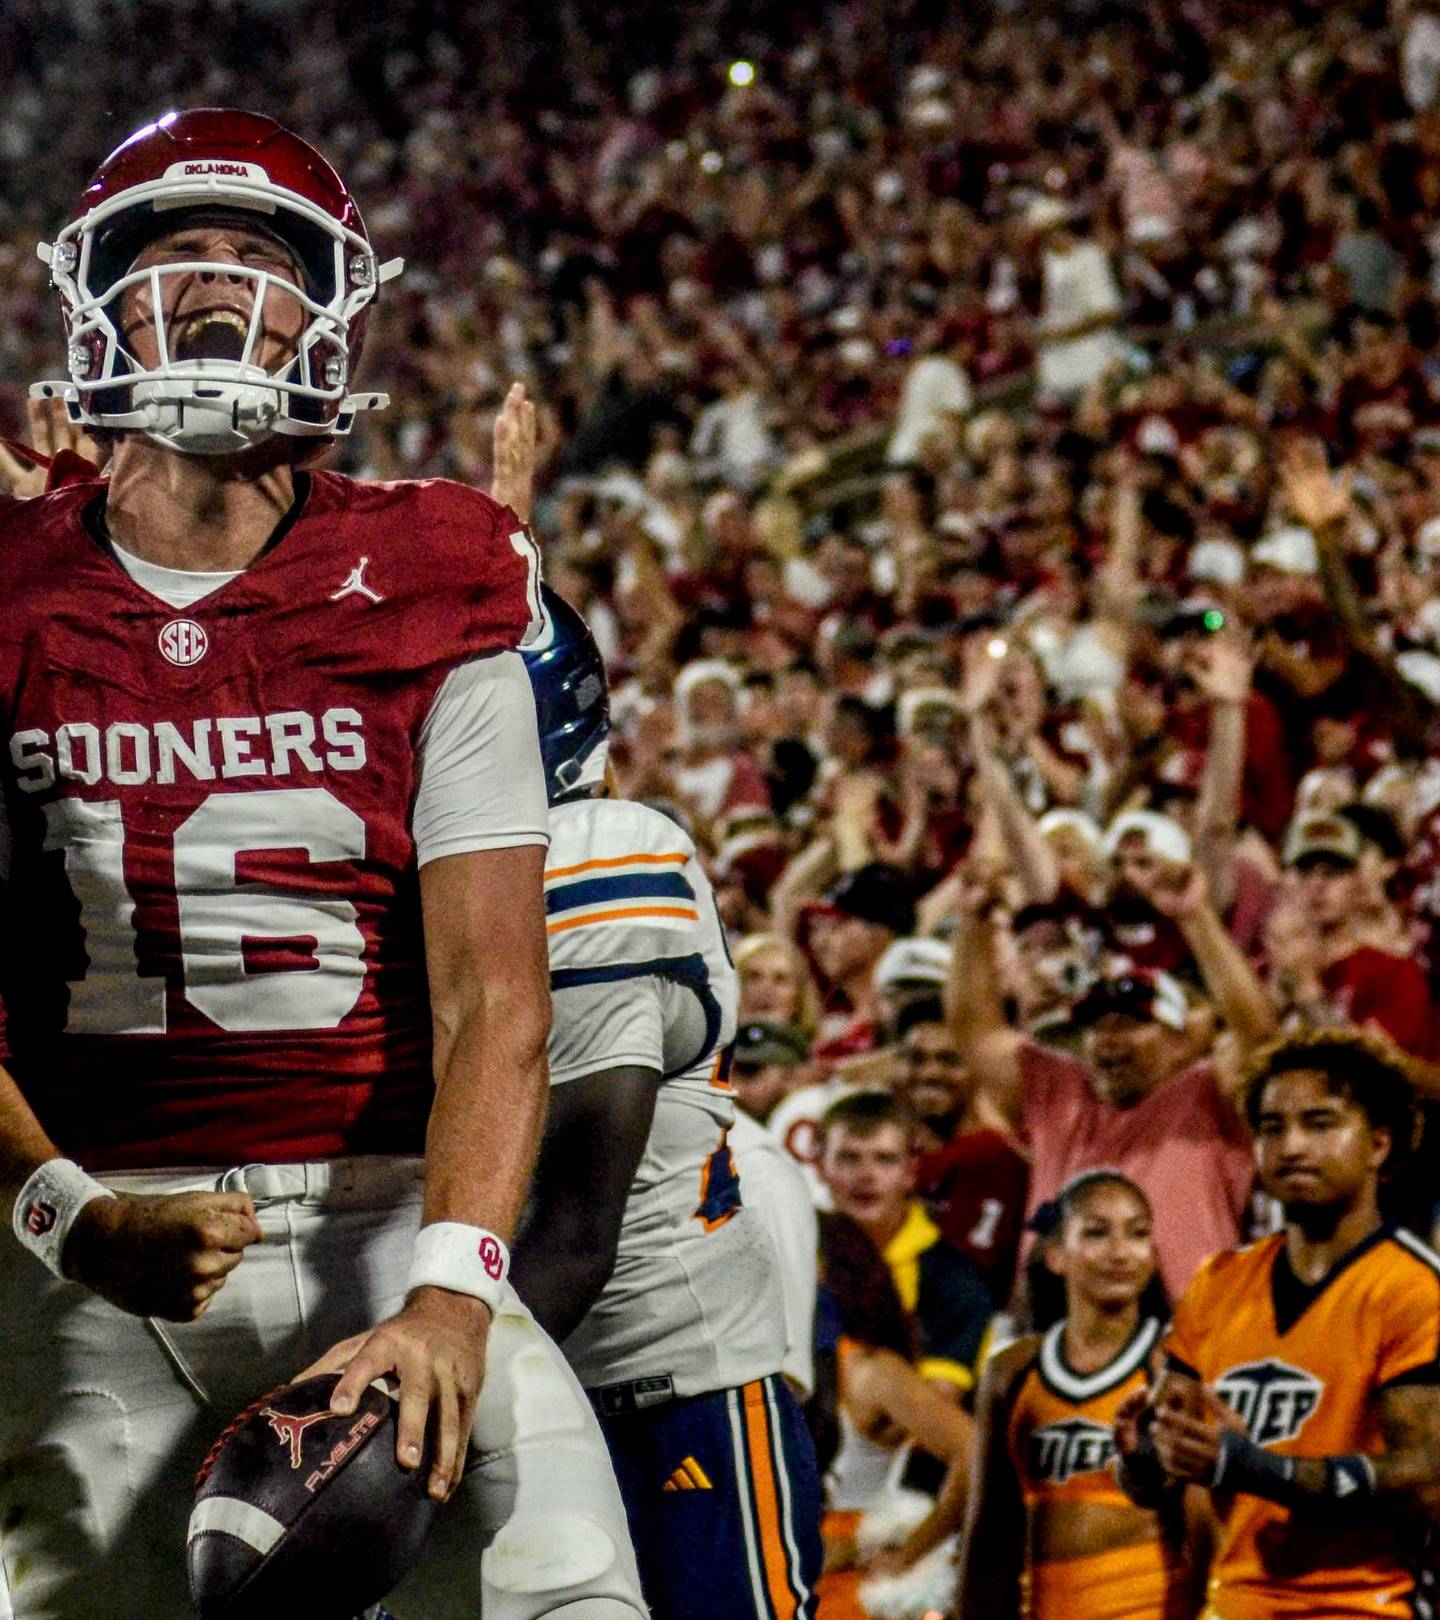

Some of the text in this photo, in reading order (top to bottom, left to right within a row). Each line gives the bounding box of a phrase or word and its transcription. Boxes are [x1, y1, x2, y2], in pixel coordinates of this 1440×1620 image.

[184, 163, 249, 177] OKLAHOMA
[162, 621, 204, 663] SEC
[9, 707, 367, 793] SOONERS
[41, 787, 368, 1034] 16
[479, 1236, 503, 1281] OU
